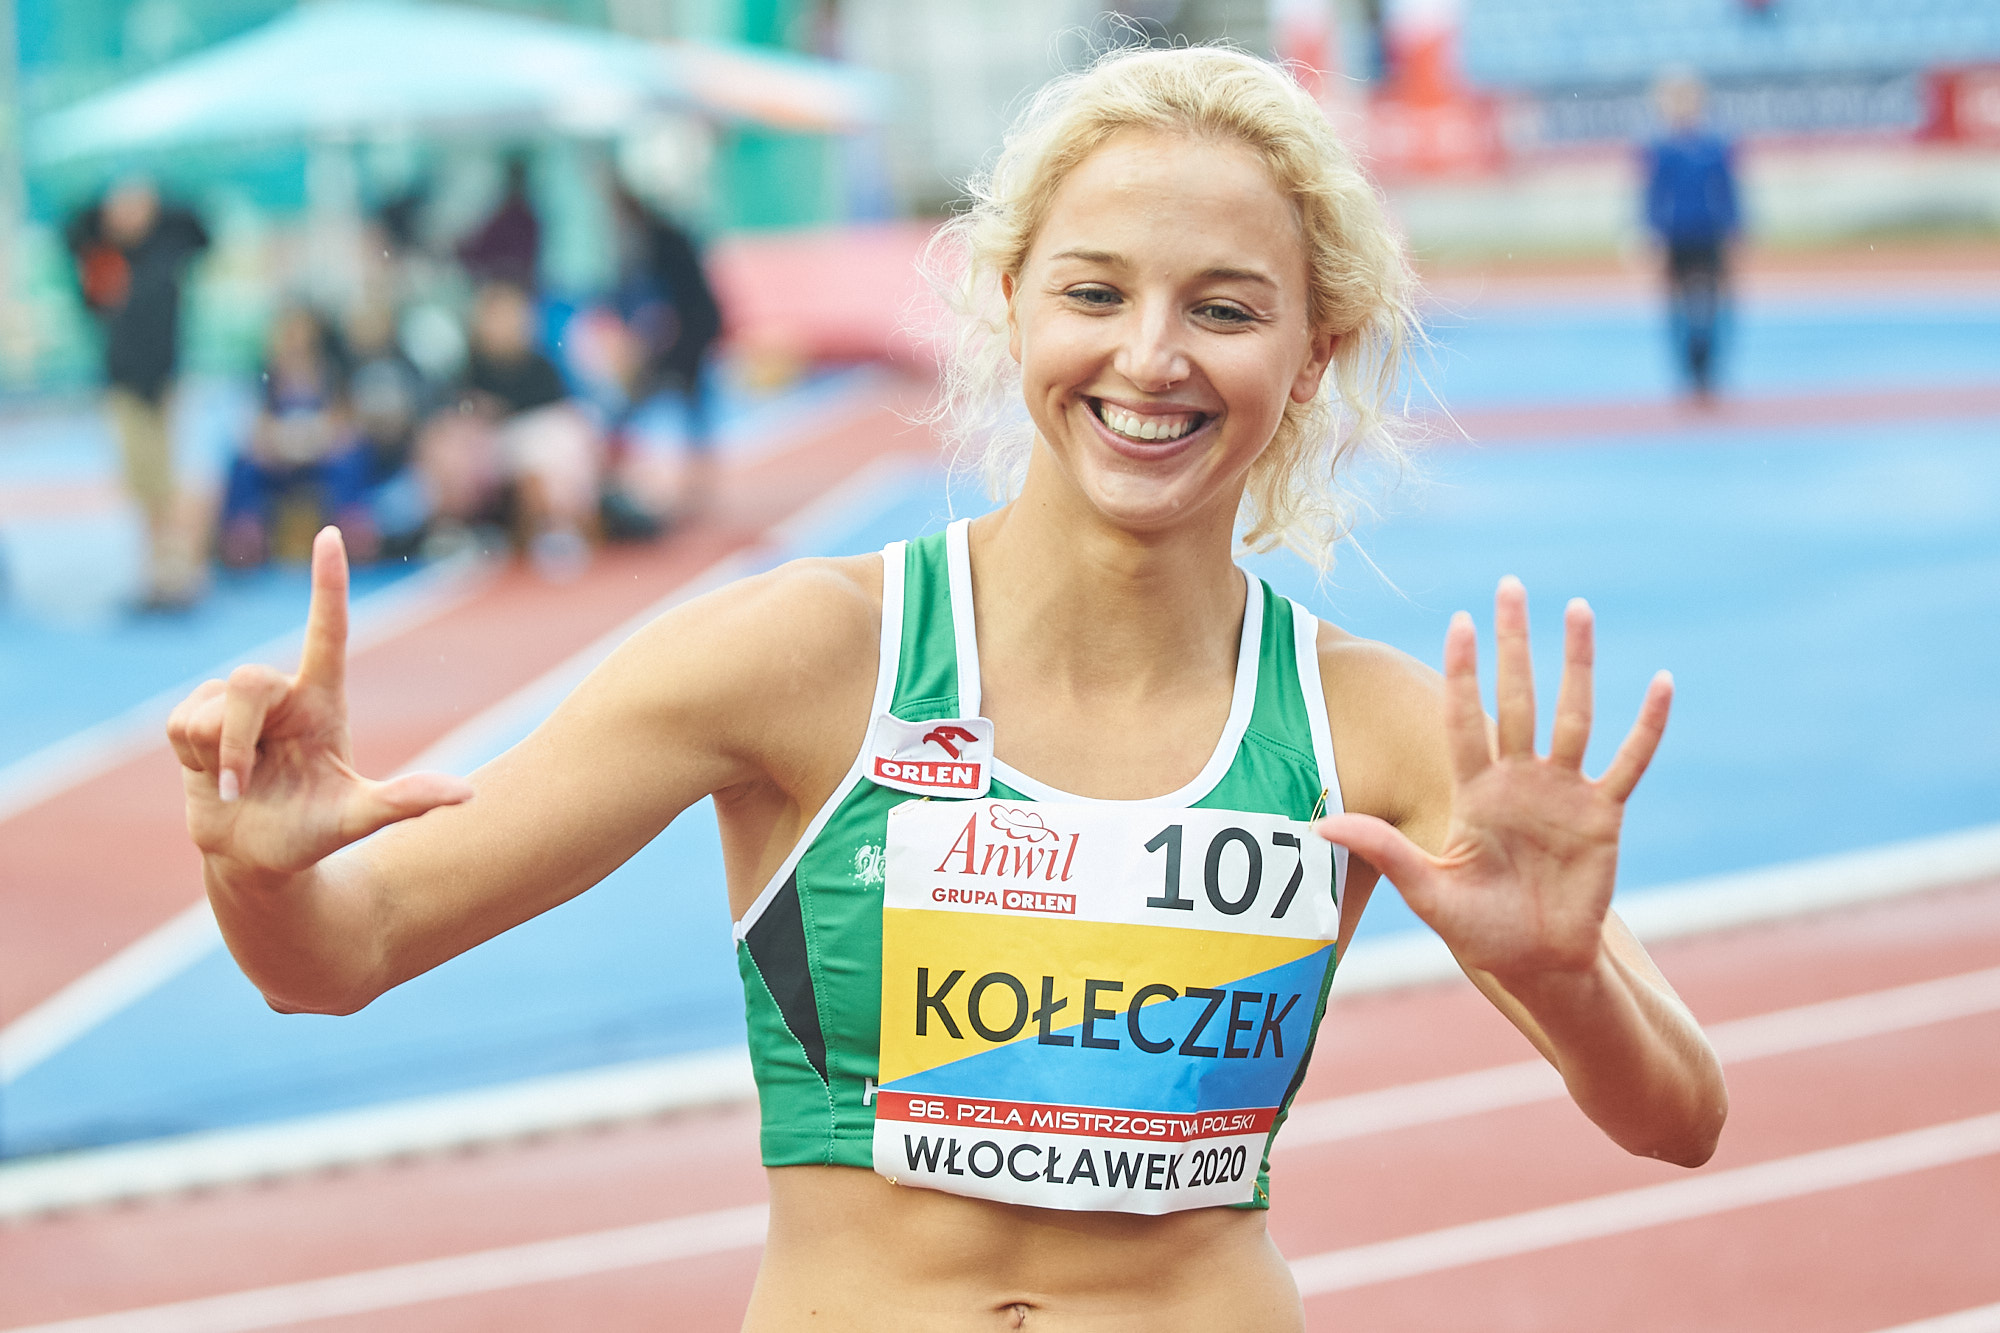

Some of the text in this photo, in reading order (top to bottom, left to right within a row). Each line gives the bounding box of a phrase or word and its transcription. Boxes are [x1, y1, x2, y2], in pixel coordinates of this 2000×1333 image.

[881, 763, 973, 785] ORLEN
[934, 811, 1080, 883] Anwil
[1144, 824, 1304, 919] 107
[931, 887, 1073, 912] GRUPA ORLEN
[915, 967, 1302, 1059] KOŁECZEK
[908, 1099, 1256, 1137] 96. PZLA MISTRZOSTWA POLSKI
[904, 1134, 1248, 1191] WŁOCŁAWEK 2020
